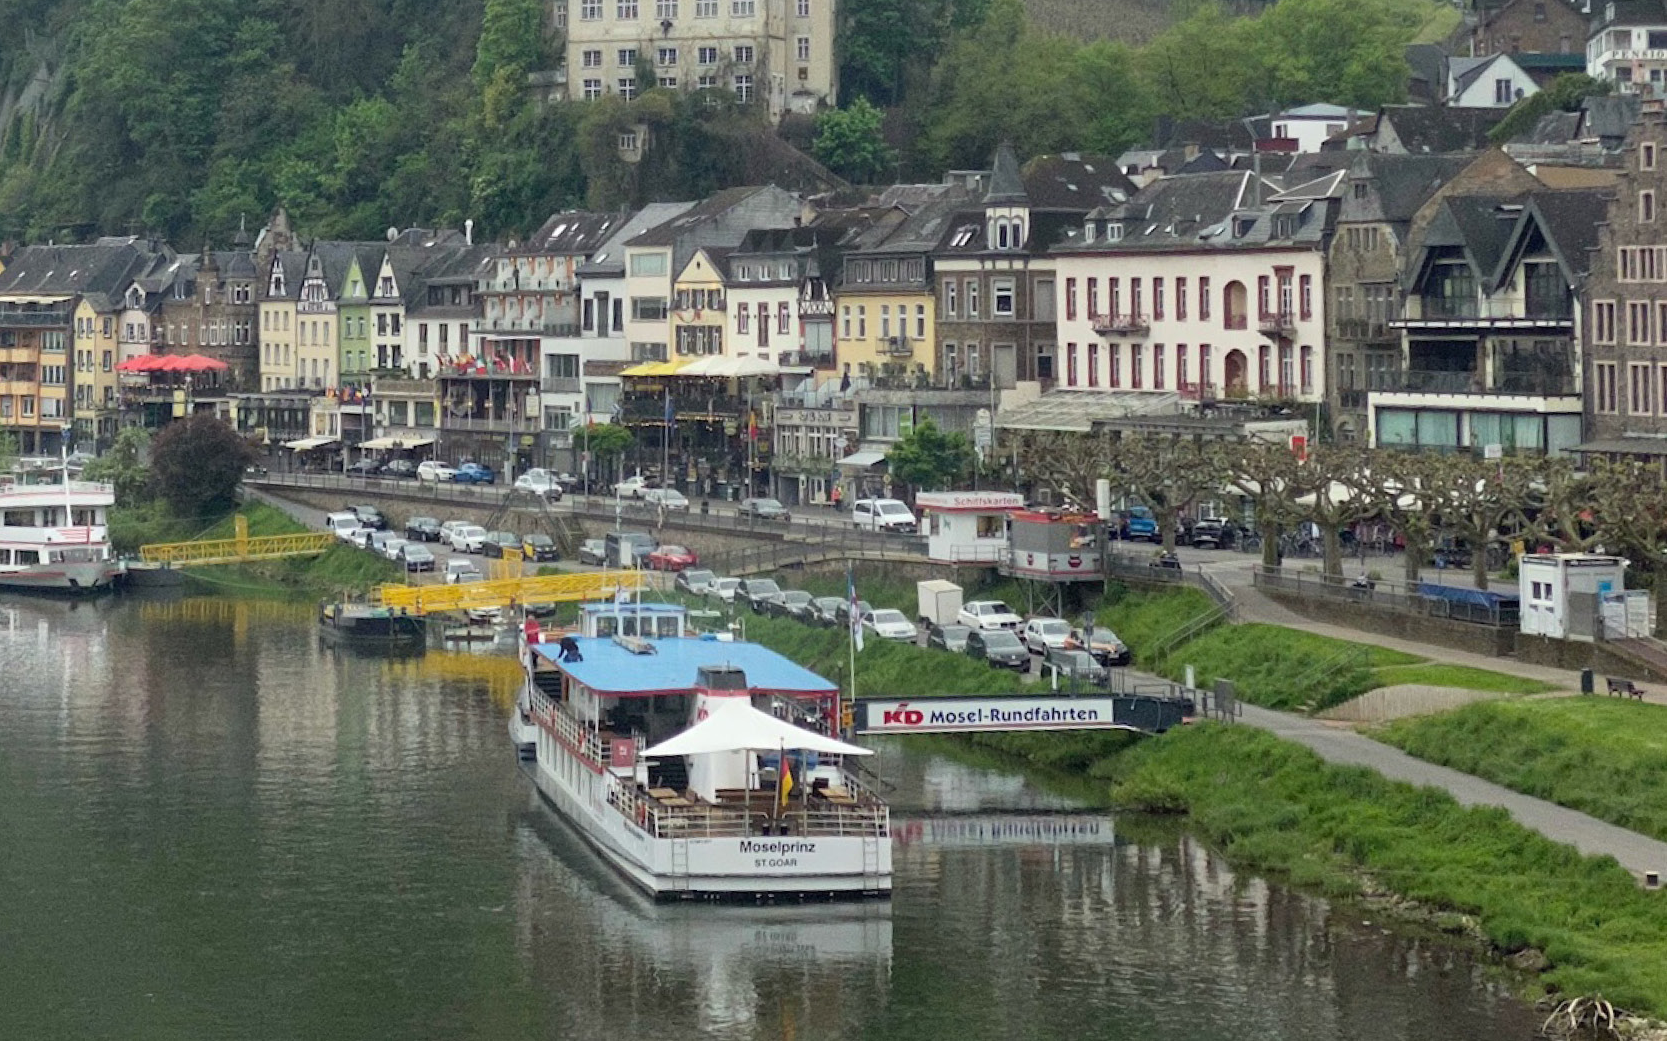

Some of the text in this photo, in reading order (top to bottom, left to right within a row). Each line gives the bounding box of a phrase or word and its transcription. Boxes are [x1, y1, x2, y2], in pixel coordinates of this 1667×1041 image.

[954, 496, 1020, 507] Schiffskarten
[884, 706, 1098, 726] KD Mosel-Rundfahrten
[739, 840, 816, 856] Moselprinz
